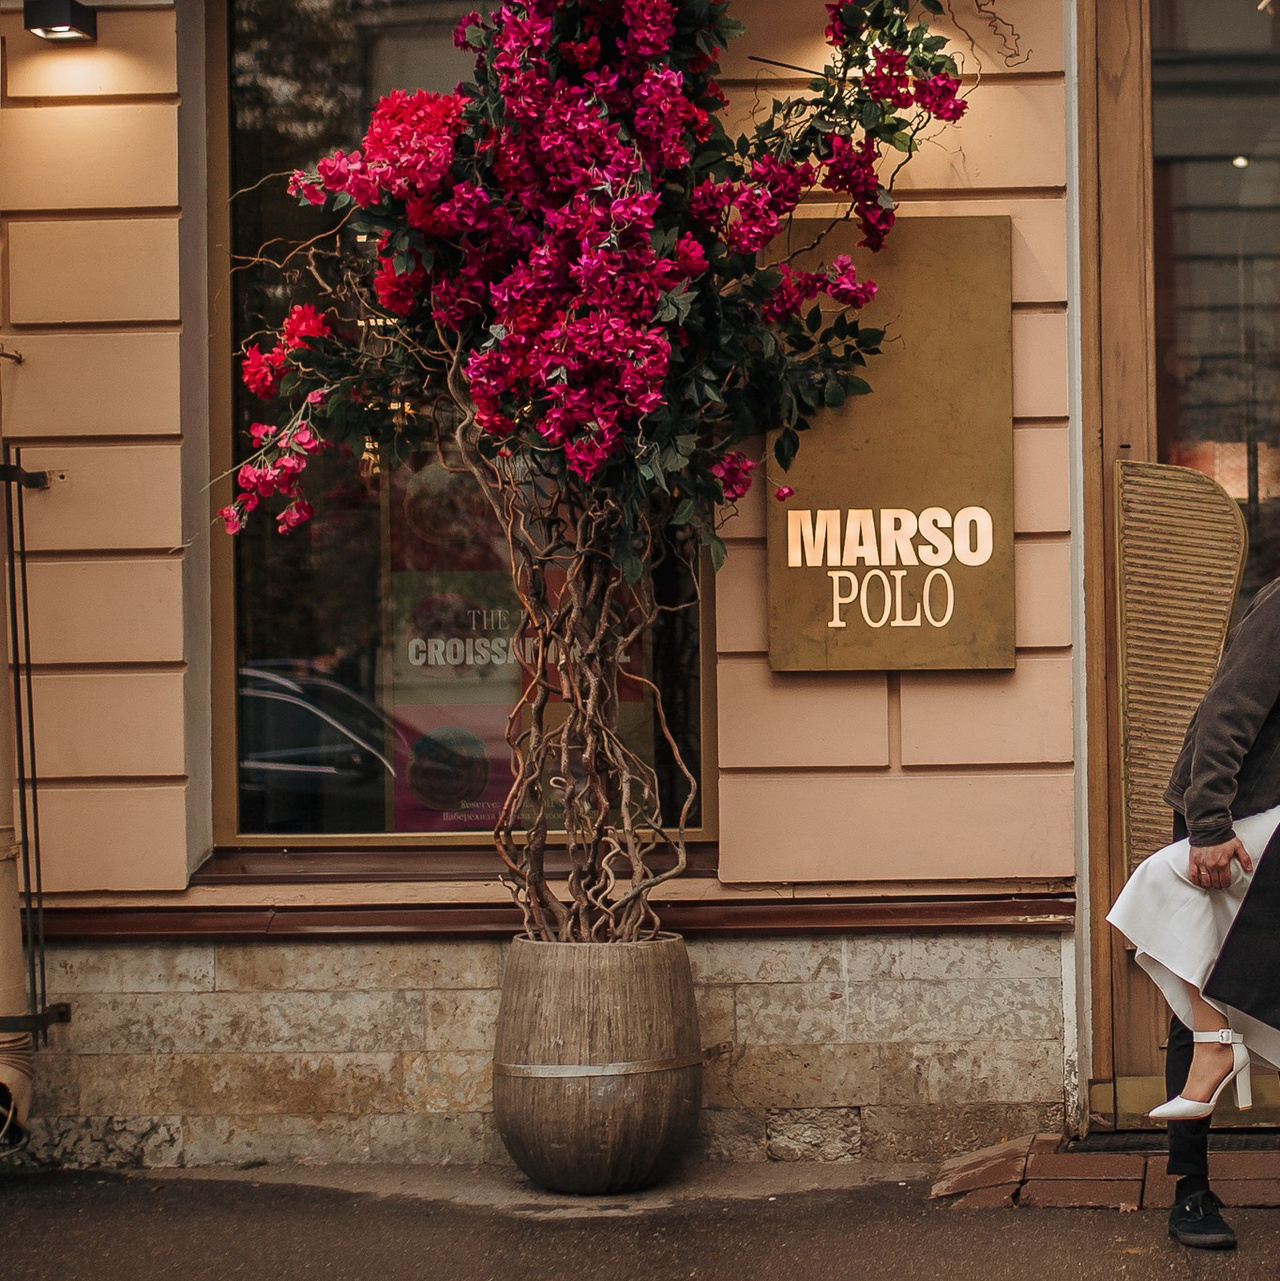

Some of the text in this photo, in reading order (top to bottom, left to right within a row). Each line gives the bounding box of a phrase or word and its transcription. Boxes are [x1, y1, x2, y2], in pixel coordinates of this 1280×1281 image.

[787, 506, 994, 568] MARSO
[467, 609, 510, 631] THE
[827, 568, 955, 628] POLO
